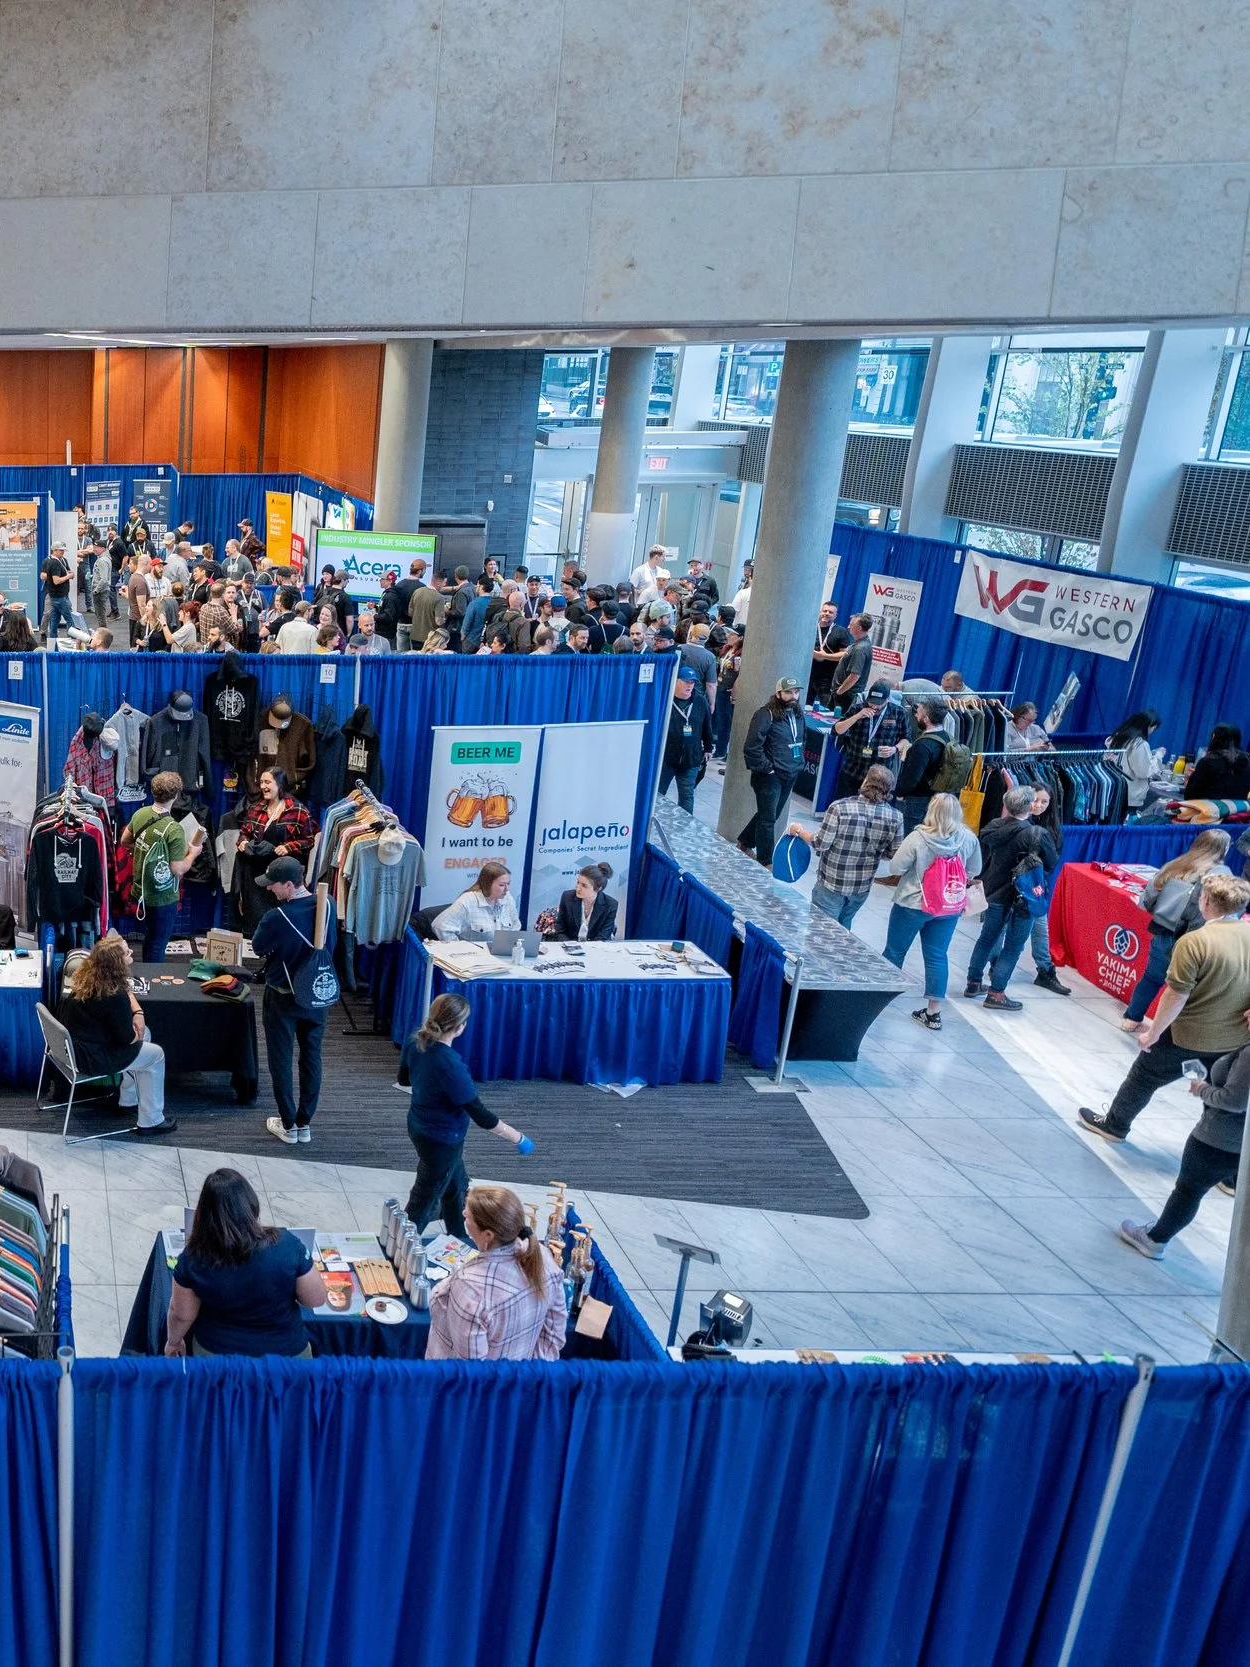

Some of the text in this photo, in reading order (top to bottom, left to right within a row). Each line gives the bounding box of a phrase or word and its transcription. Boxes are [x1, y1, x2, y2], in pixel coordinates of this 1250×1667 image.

[770, 362, 778, 372] P
[882, 370, 894, 380] 30
[650, 458, 668, 468] EXIT
[321, 534, 432, 548] INDUSTRY MINGLER SPONSOR
[342, 554, 402, 578] Acera
[873, 584, 894, 598] WG
[895, 593, 916, 602] GASCO
[973, 564, 1050, 626] WG
[1055, 584, 1136, 612] WESTERN
[1050, 606, 1133, 644] GASCO
[2, 723, 30, 736] Linde
[457, 747, 515, 758] BEER ME
[11, 758, 22, 768] for:
[539, 820, 630, 846] jalapeño
[441, 836, 513, 847] I want to be
[1097, 951, 1137, 980] YAKIMA
[1098, 966, 1130, 988] CHIEF
